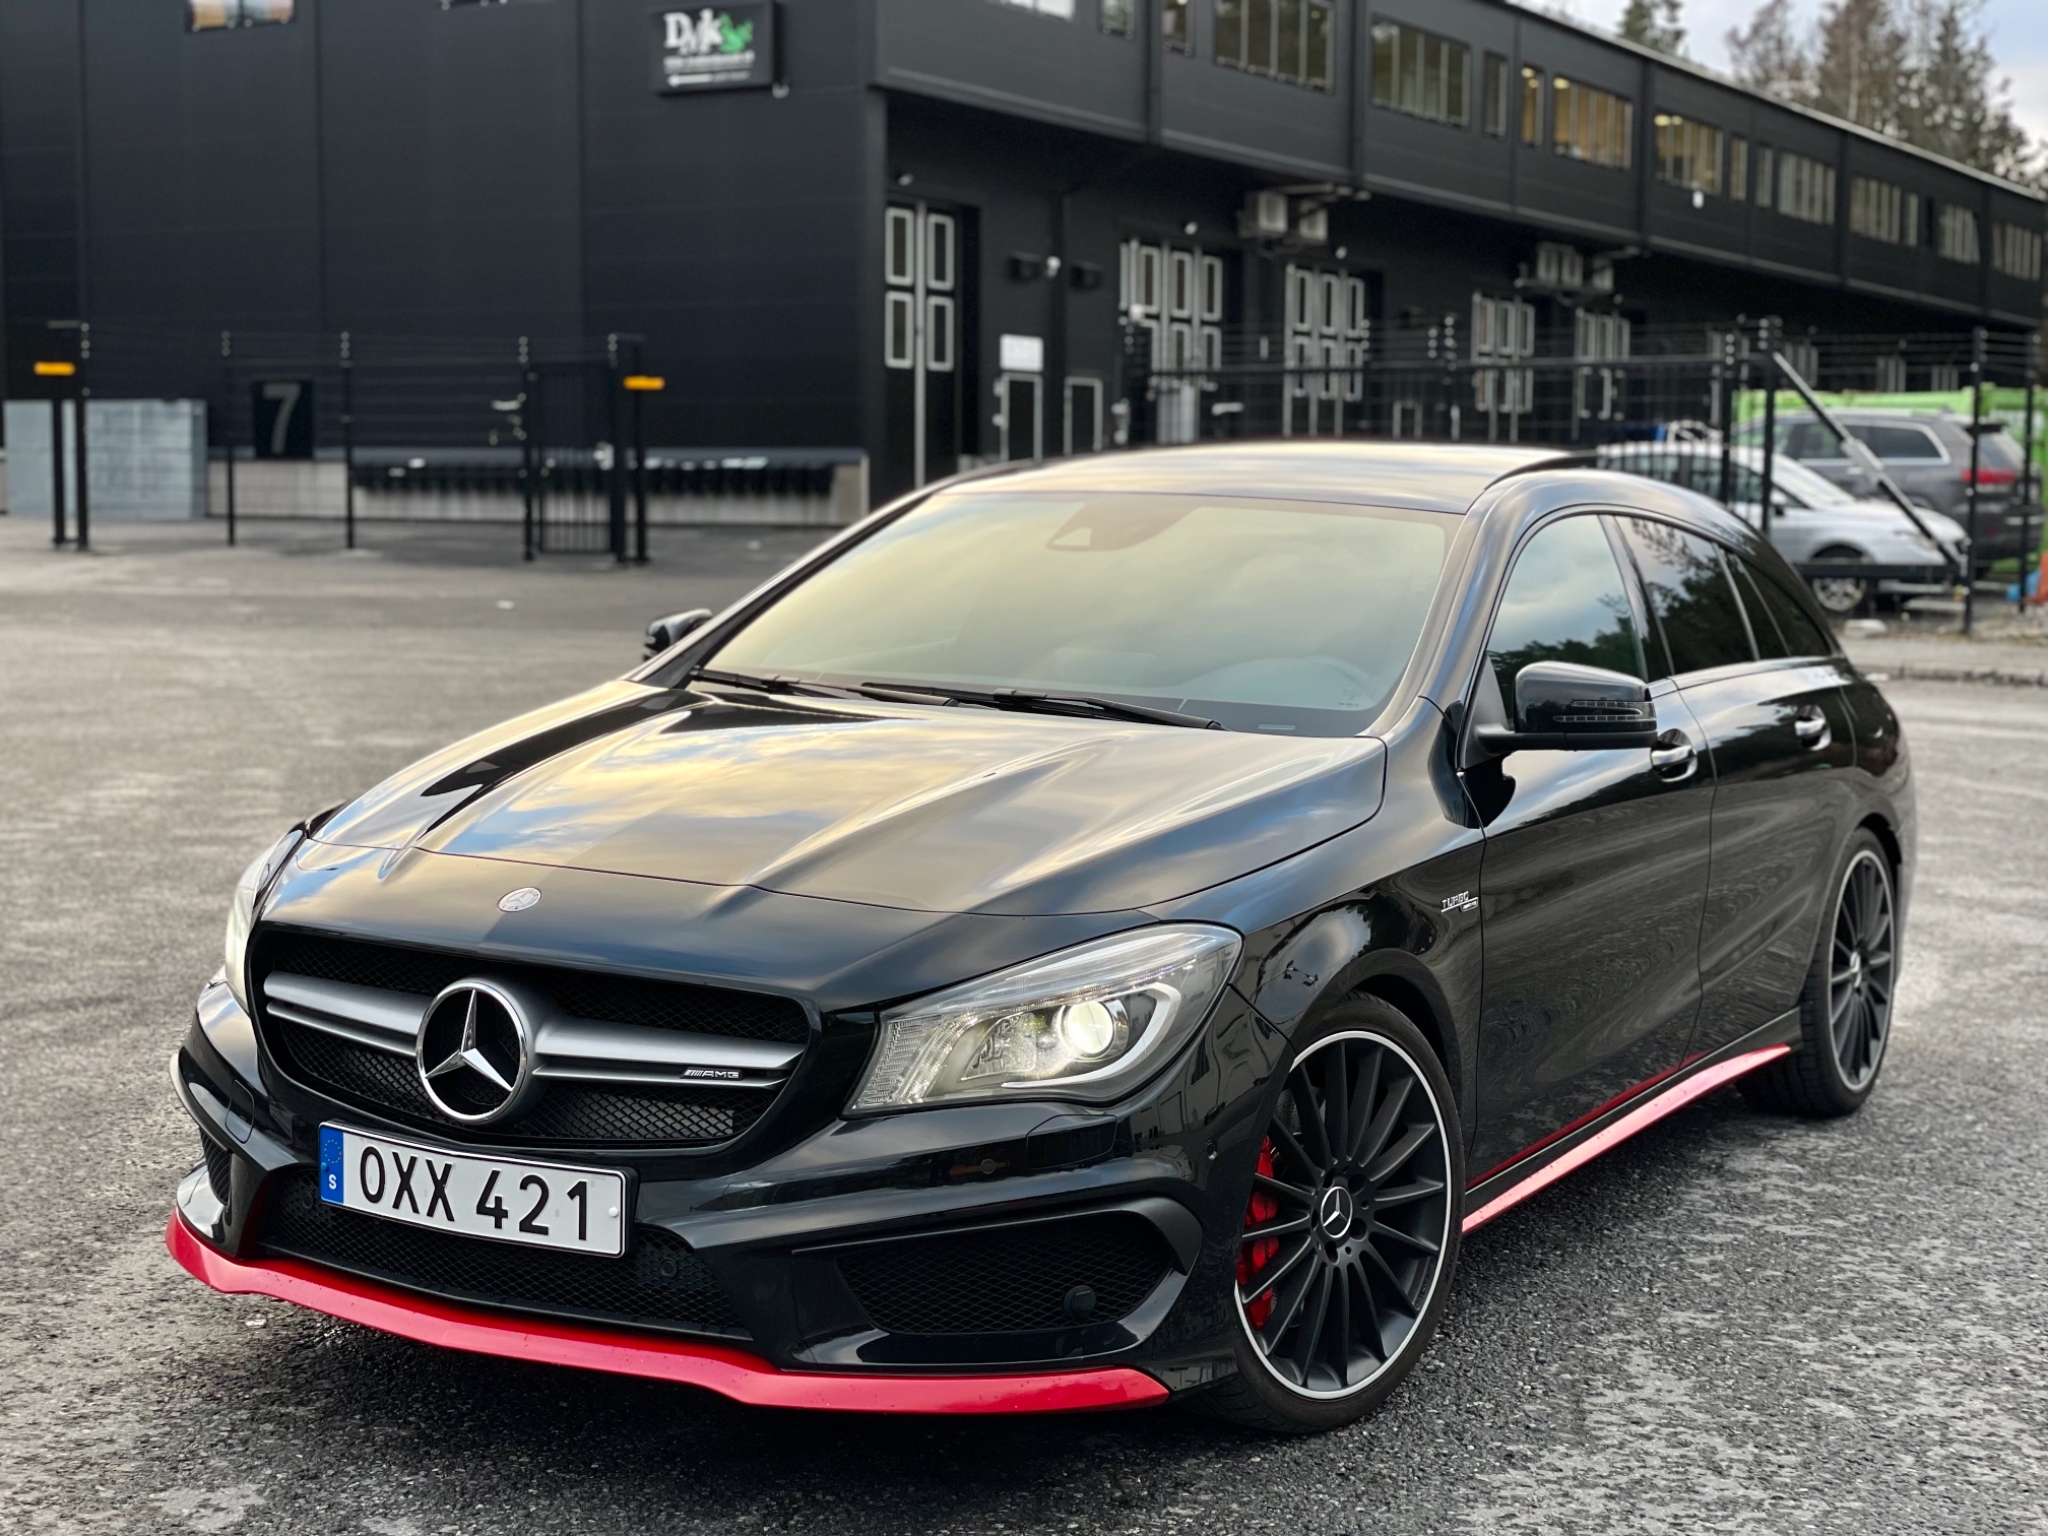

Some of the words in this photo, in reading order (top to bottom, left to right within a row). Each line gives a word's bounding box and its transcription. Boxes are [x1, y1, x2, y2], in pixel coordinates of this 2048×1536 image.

[263, 382, 301, 455] 7
[701, 1070, 740, 1079] AMG
[328, 1174, 337, 1190] S
[359, 1146, 455, 1222] OXX
[476, 1169, 588, 1241] 421
